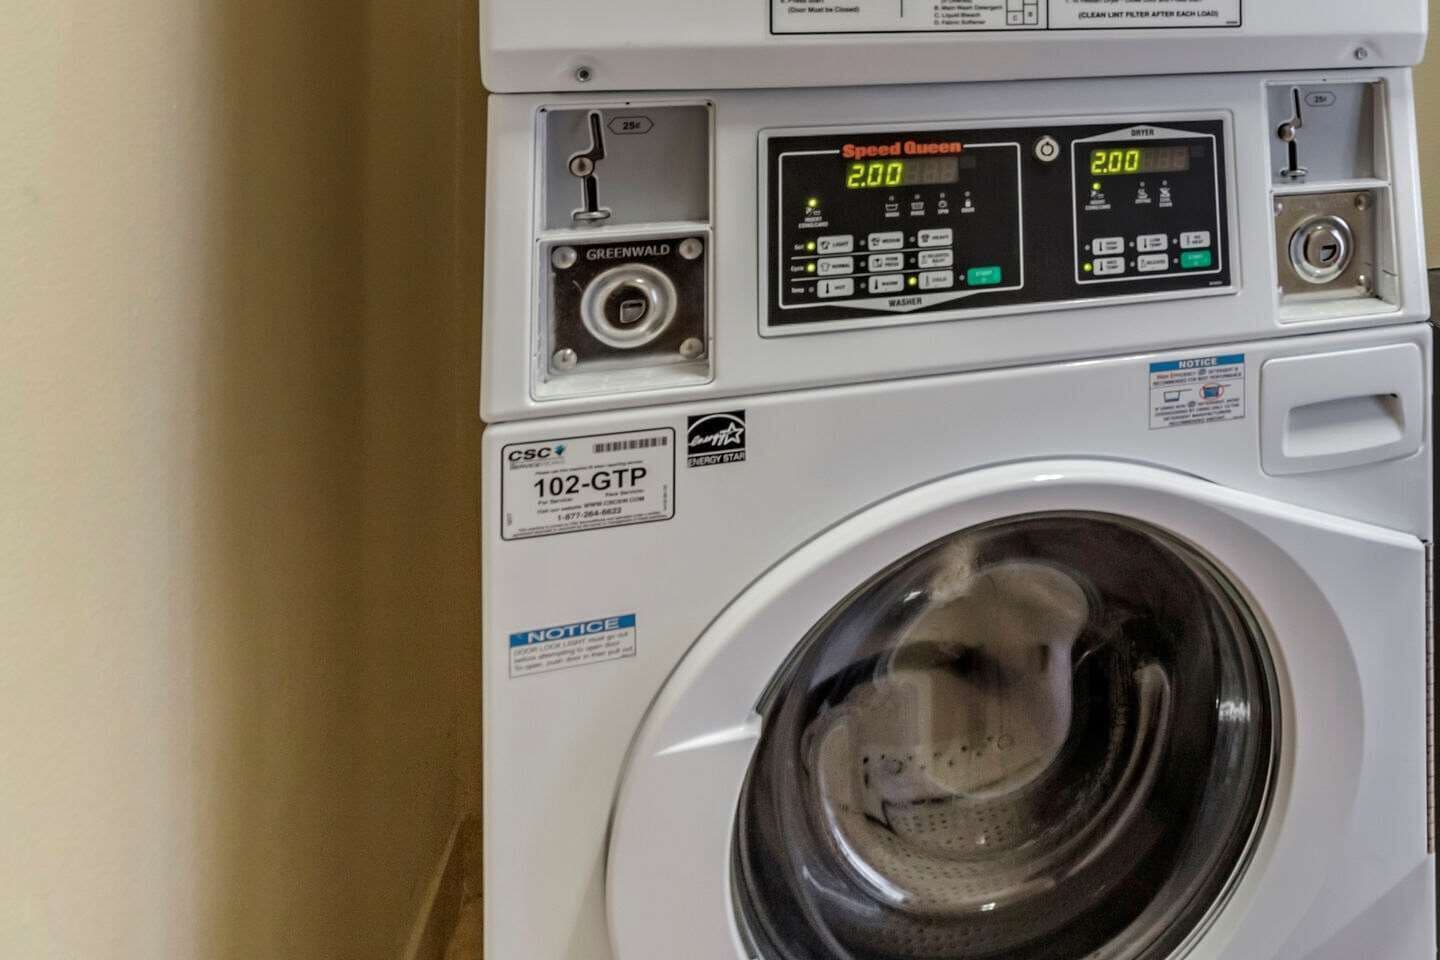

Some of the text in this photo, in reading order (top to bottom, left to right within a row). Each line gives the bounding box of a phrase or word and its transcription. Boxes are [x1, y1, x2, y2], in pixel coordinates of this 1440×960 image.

[1079, 10, 1218, 19] (CLEAN LINT FILTER AFTER EACH LOAD)
[1131, 129, 1155, 137] DRYER
[842, 141, 962, 160] Speed Queen
[1091, 150, 1139, 173] 2.00
[848, 162, 903, 189] 2.00
[586, 244, 670, 260] GREENWALD
[888, 298, 922, 308] WASHER
[1179, 357, 1217, 369] NOTICE
[508, 447, 552, 462] CSC
[689, 451, 746, 468] ENERGY STAR
[534, 467, 647, 498] 102-GTP
[528, 617, 619, 643] NOTICE
